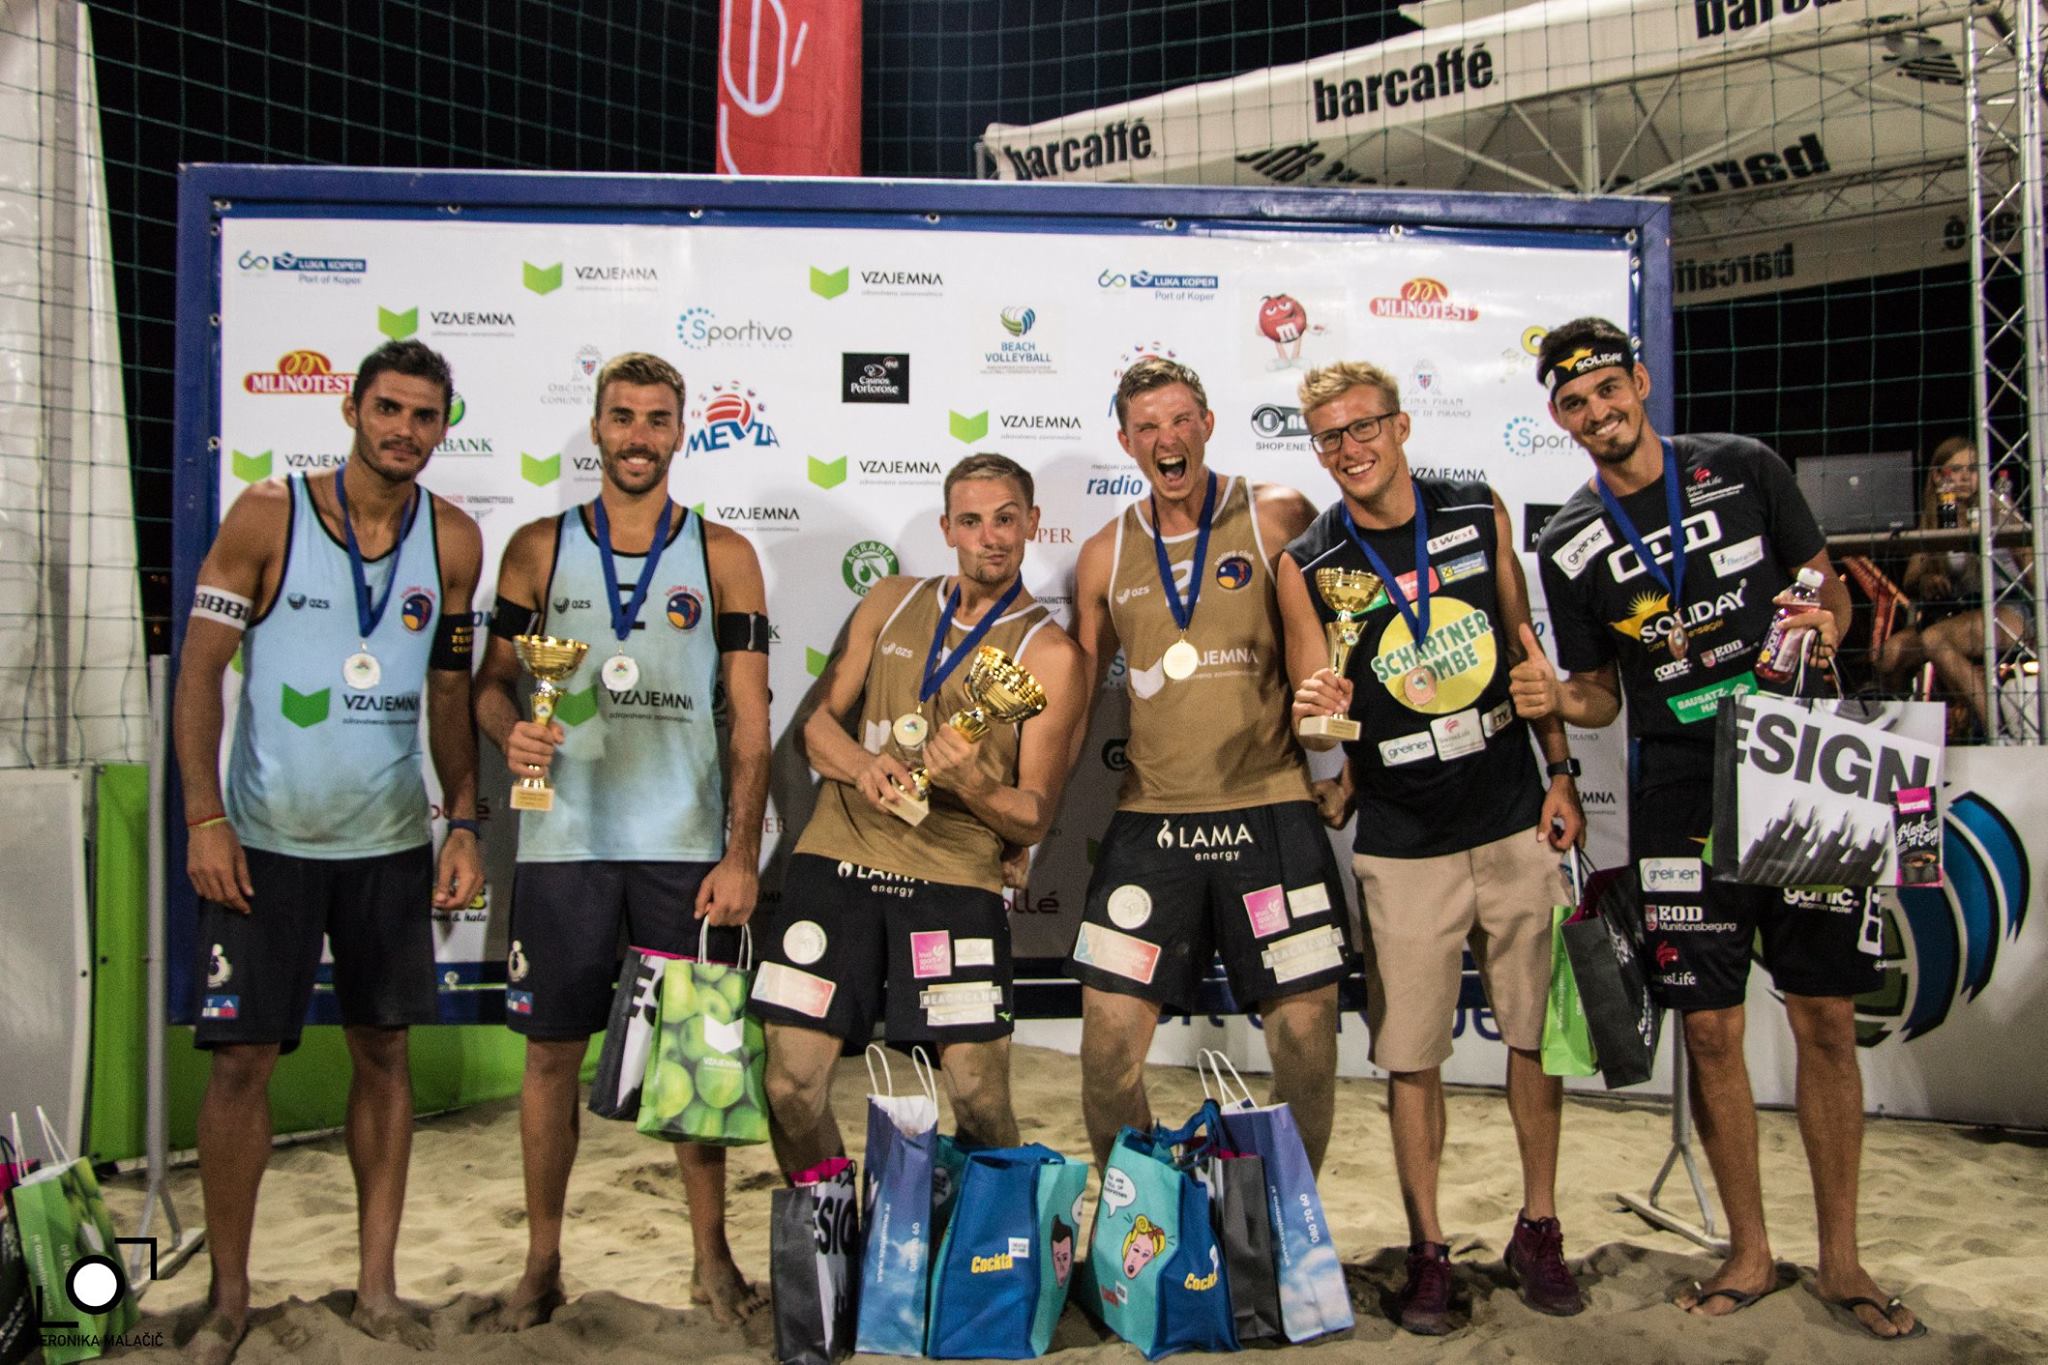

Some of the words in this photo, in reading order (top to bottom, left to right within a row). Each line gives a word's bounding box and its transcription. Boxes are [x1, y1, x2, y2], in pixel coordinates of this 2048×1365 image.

[1312, 43, 1494, 123] barcaffé
[1004, 117, 1153, 181] barcaffé
[298, 259, 325, 271] LUKA
[327, 260, 365, 271] KOPER
[298, 273, 317, 283] Port
[333, 275, 362, 286] Koper
[575, 266, 658, 281] VZAJEMNA
[860, 271, 944, 286] VZAJEMNA
[1154, 277, 1180, 287] LUKA
[1182, 277, 1216, 288] KOPER
[1155, 291, 1173, 301] Port
[1176, 291, 1186, 300] of
[1187, 292, 1215, 303] Koper
[1376, 299, 1472, 321] MLINOTEST
[431, 312, 516, 327] VZAJEMNA
[692, 319, 793, 346] Sportivo
[1001, 341, 1036, 352] BEACH
[984, 352, 1052, 363] VOLLEYBALL
[249, 374, 356, 393] MLINOTEST
[850, 383, 900, 395] Portorose
[1000, 415, 1082, 430] VZAJEMNA
[285, 454, 349, 468] VZAJEM
[859, 460, 942, 475] VZAJEMNA
[1086, 475, 1143, 496] radio
[717, 506, 800, 521] VZAJEMNA
[1640, 587, 1745, 645] SOLIDAY
[1372, 610, 1491, 681] SCHARTNER
[1423, 643, 1479, 682] OMBE
[342, 693, 420, 712] VZAJEMN
[608, 689, 694, 711] VZAJEMNA
[1179, 823, 1254, 849] LAMA
[1195, 849, 1241, 862] energy
[1648, 866, 1701, 883] greiner
[871, 884, 914, 898] energy
[1658, 905, 1704, 922] EOD
